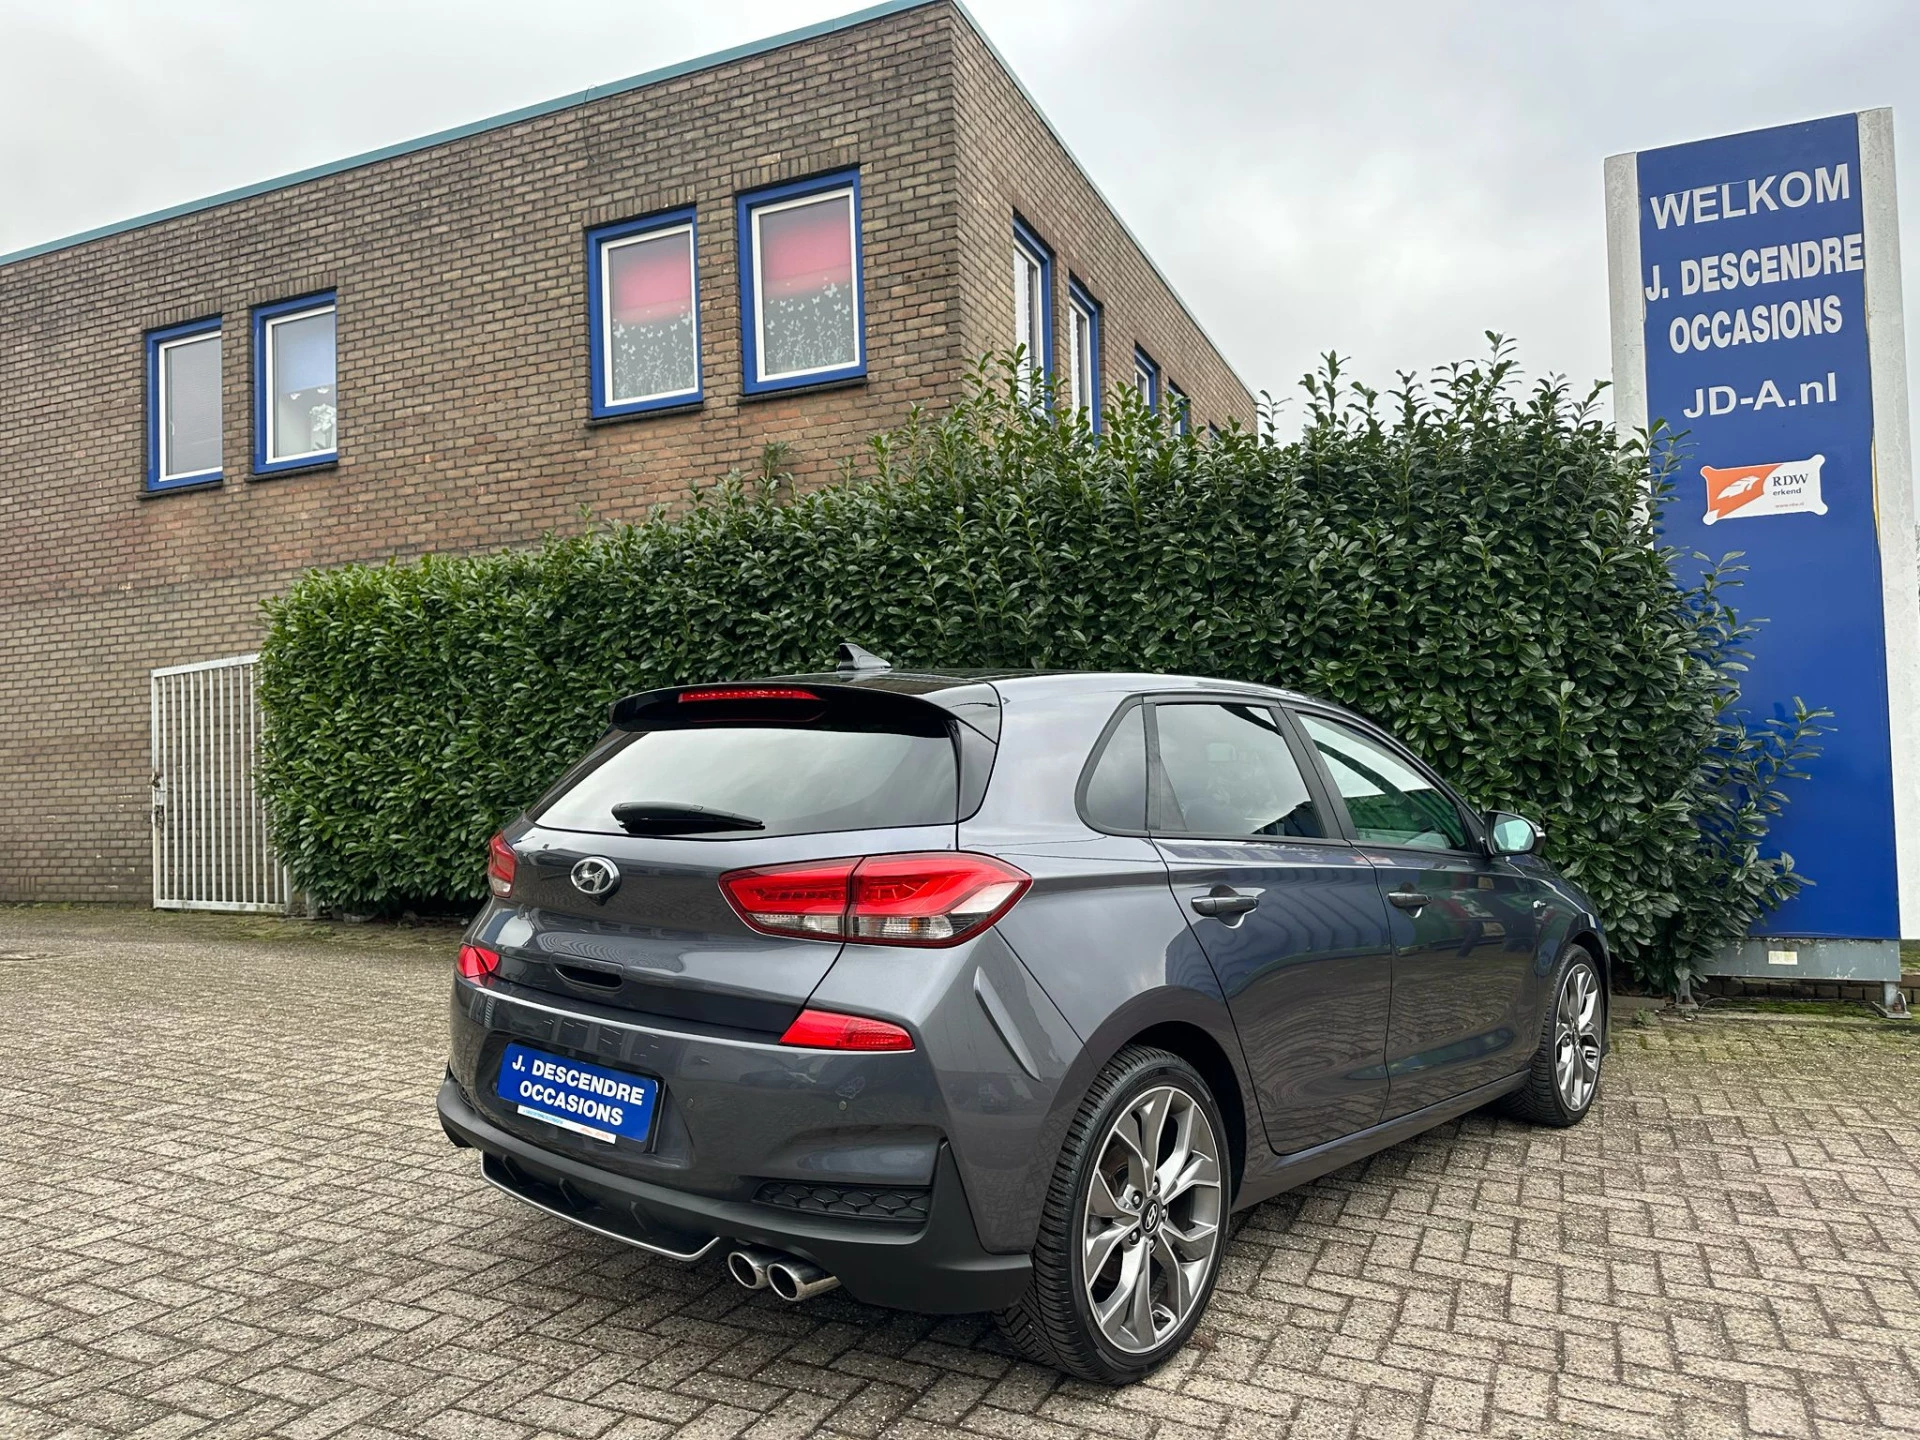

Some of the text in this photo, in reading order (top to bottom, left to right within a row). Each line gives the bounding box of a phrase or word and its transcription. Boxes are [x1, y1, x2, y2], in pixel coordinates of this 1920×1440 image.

[1650, 163, 1850, 230] WELKOM
[1645, 233, 1864, 301] J. DESCENDRE
[1669, 295, 1843, 354] OCCASIONS
[1683, 372, 1837, 418] JD-A.nl
[1772, 473, 1809, 487] RDW
[1772, 487, 1802, 496] erkend
[511, 1055, 645, 1106] J. DESCENDRE
[519, 1080, 624, 1126] OCCASIONS
